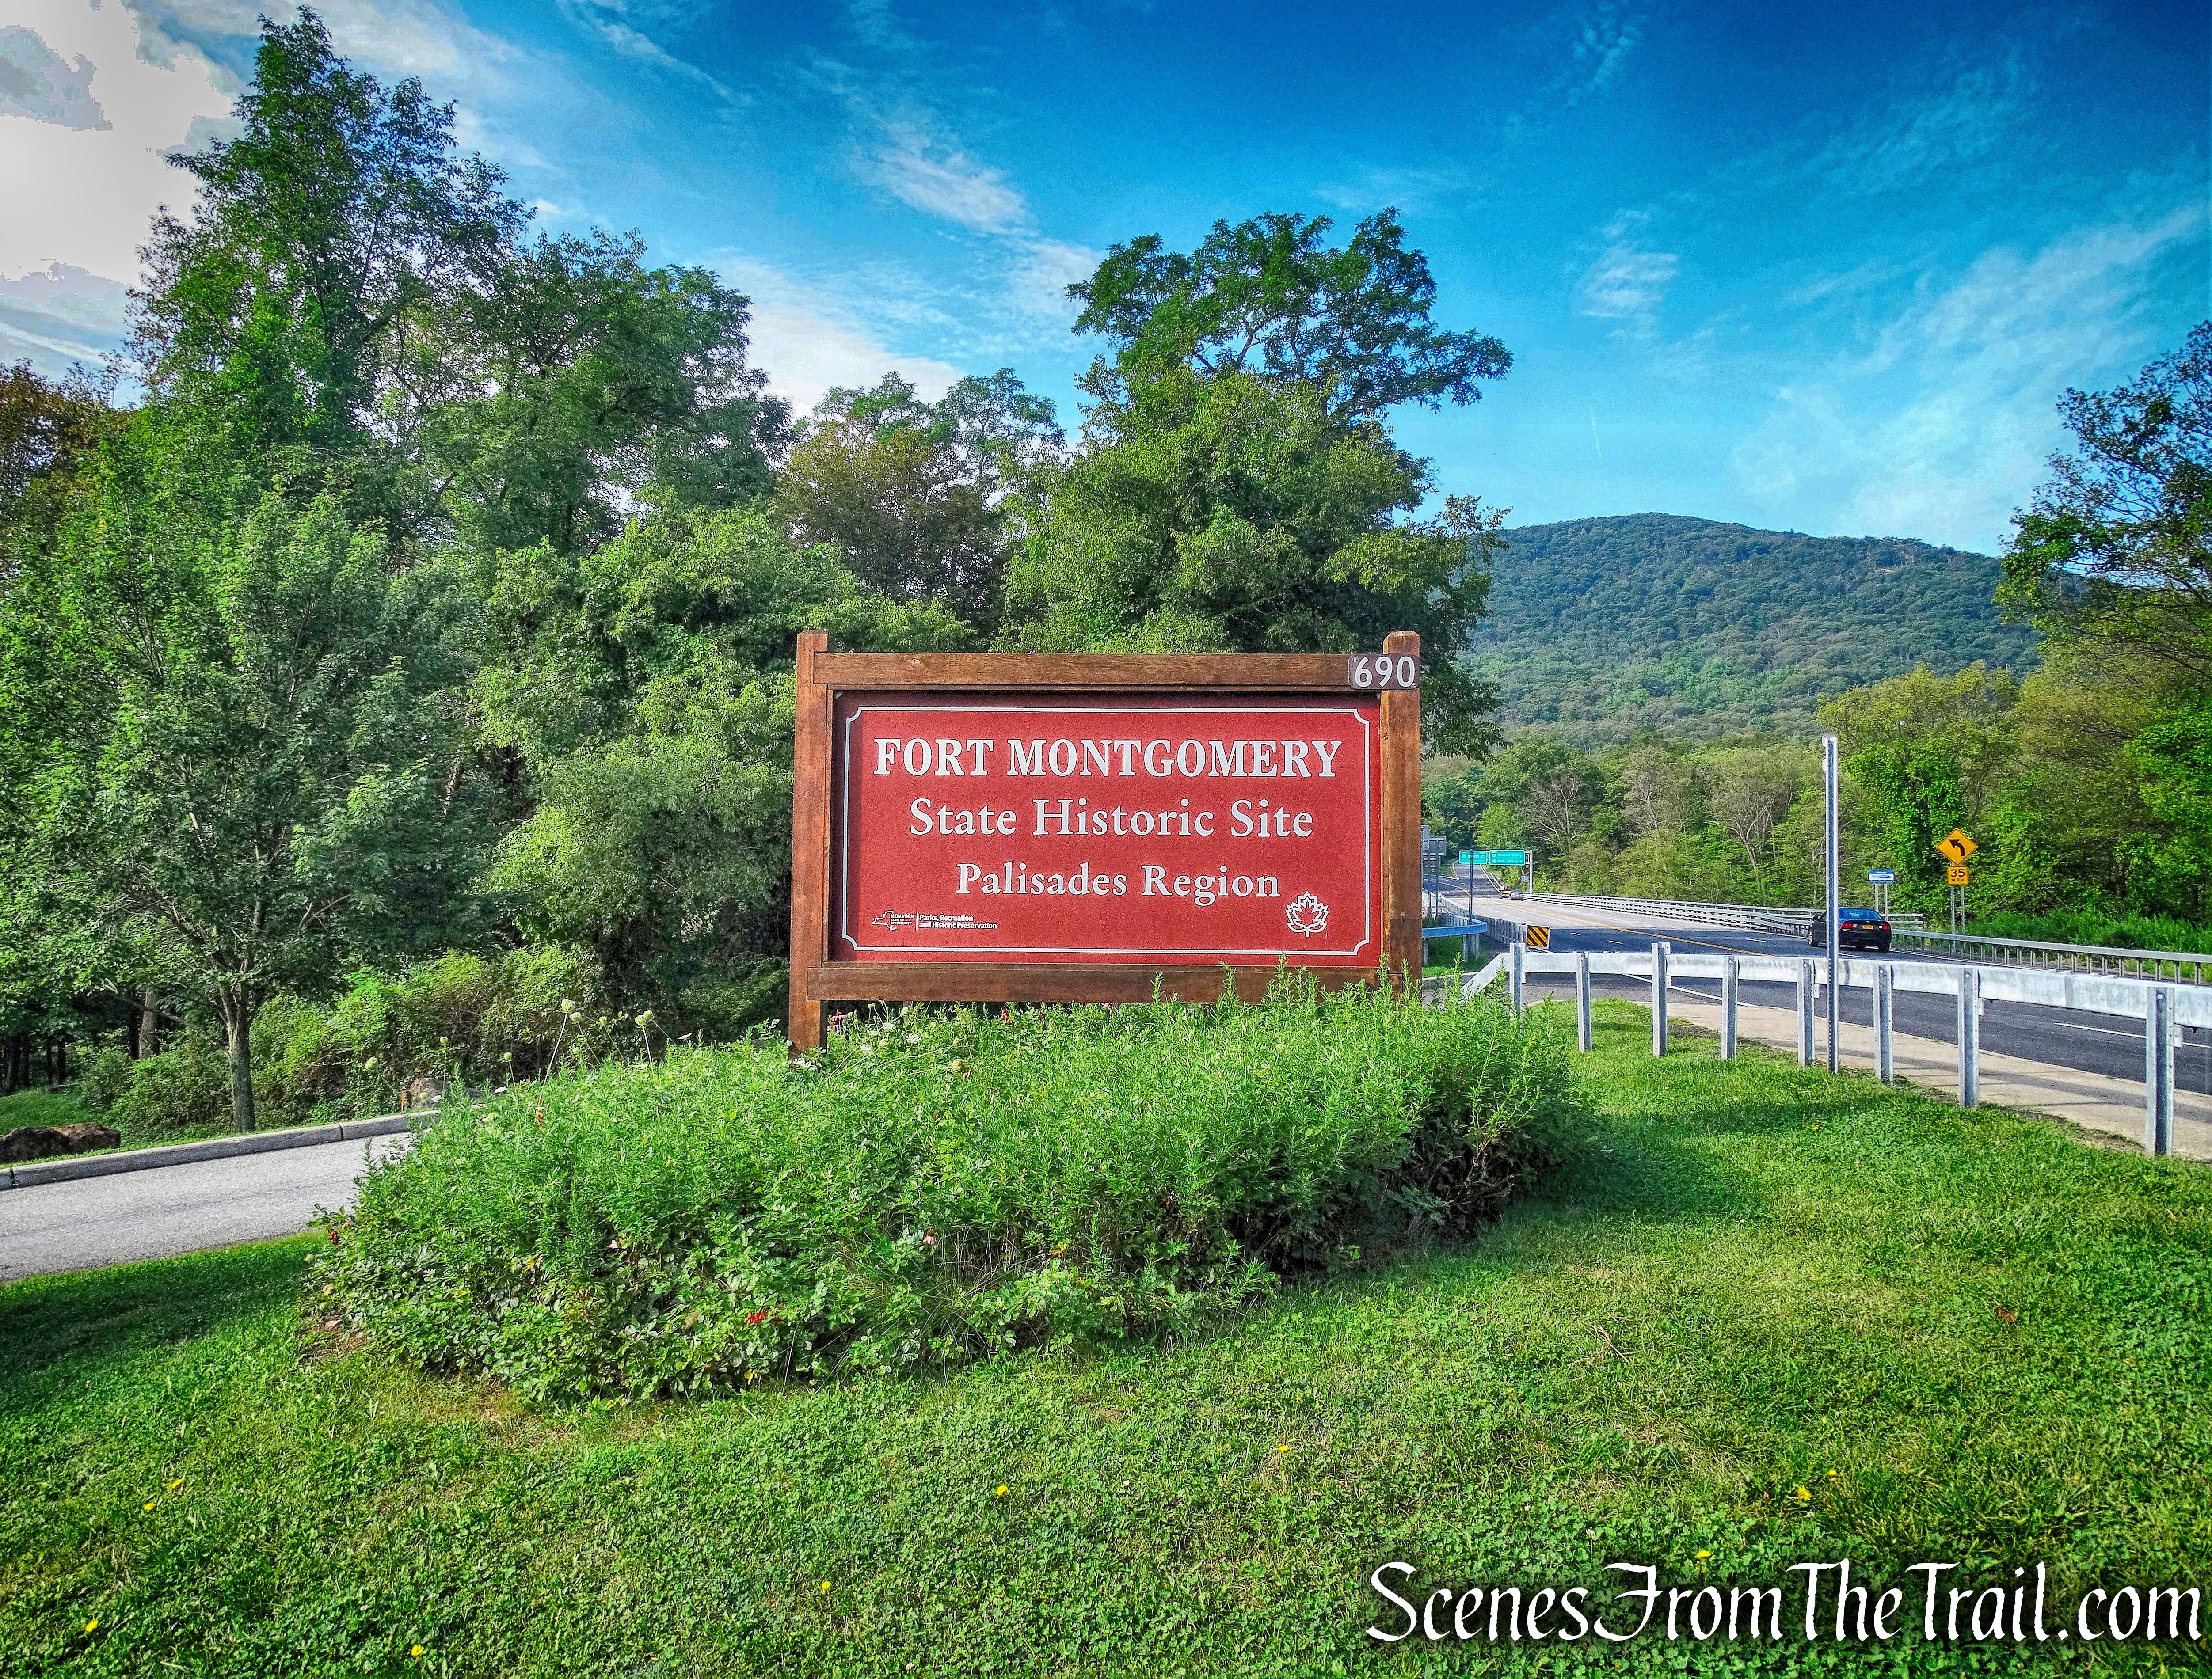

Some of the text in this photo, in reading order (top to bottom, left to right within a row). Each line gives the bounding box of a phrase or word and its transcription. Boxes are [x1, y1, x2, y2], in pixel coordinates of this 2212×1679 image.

[1355, 656, 1415, 688] 690
[874, 738, 1343, 777] FORT MONTGOMERY
[910, 798, 1313, 837] State Historic Site
[956, 861, 1280, 906] Palisades Region
[1950, 869, 1965, 877] 35
